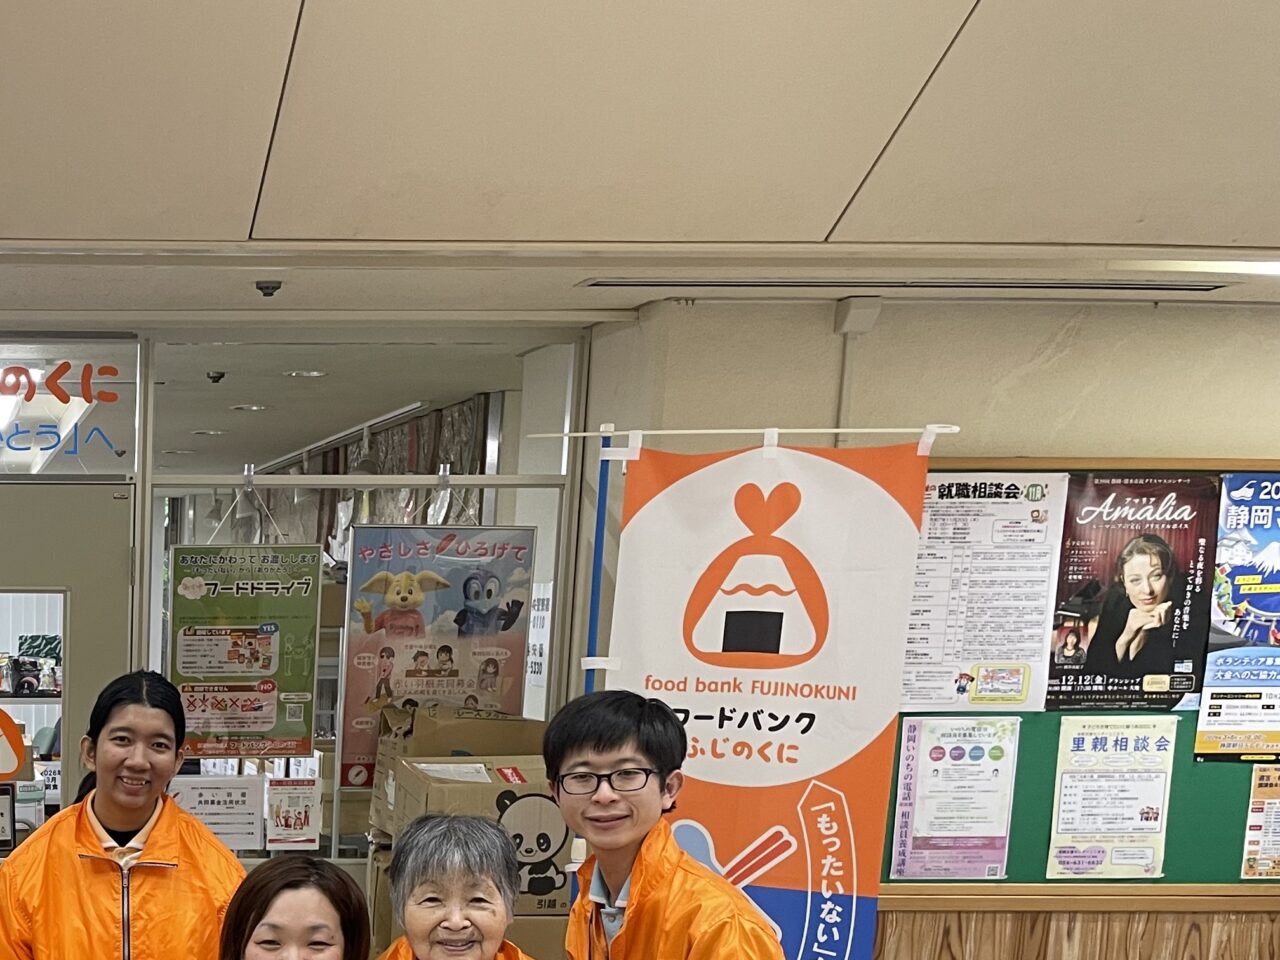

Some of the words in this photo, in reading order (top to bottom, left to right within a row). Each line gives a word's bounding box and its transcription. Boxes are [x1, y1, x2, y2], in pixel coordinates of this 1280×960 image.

[937, 482, 1021, 500] 就職相談会
[1125, 497, 1157, 505] アマリア
[1076, 492, 1197, 525] Amalia
[179, 555, 257, 565] あなたにかわって
[260, 554, 319, 564] お渡しします
[358, 540, 432, 563] やさしさ
[454, 540, 528, 562] ひろげて
[204, 577, 313, 596] フードドライブ
[260, 683, 273, 691] NO
[644, 674, 688, 693] food
[695, 677, 743, 694] bank
[751, 679, 858, 701] FUJINOKUNI
[672, 706, 817, 735] フードバンク
[687, 737, 801, 764] ふじのくに
[1070, 735, 1171, 752] 里親相談会
[902, 724, 918, 801] 静岡いのちの電話
